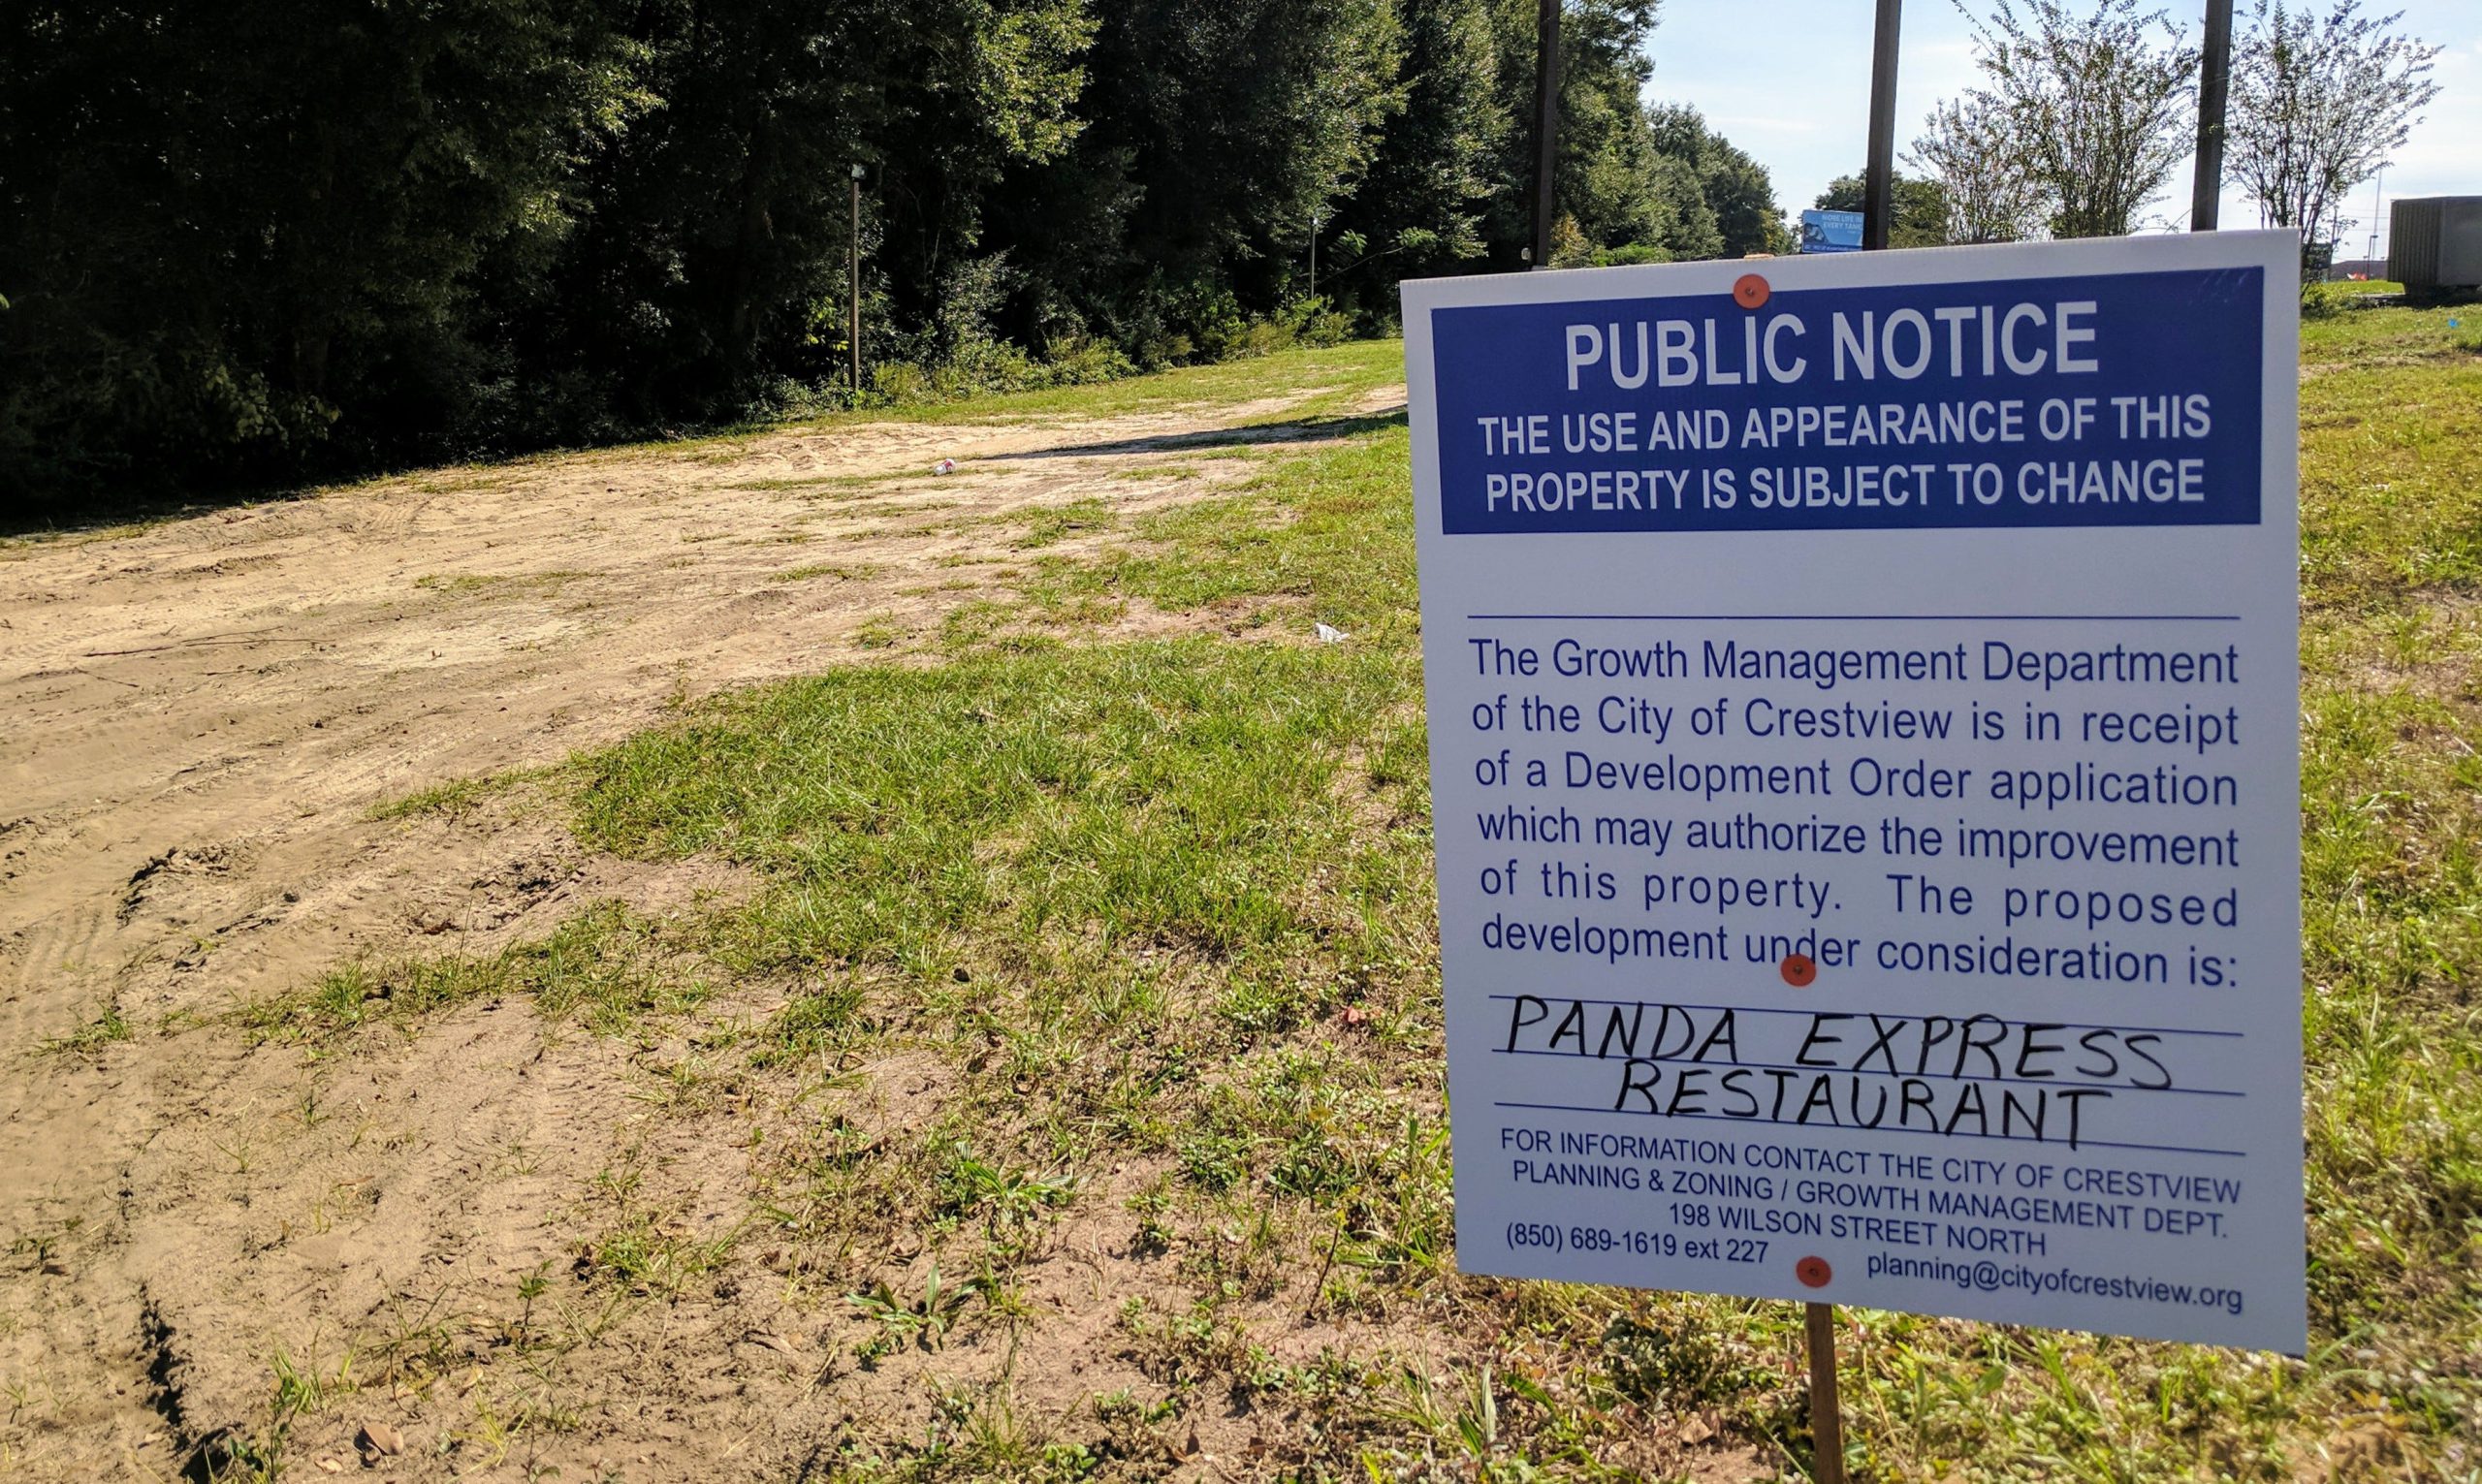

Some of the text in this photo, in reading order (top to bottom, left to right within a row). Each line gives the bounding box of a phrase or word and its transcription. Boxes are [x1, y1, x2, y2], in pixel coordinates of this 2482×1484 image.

[1566, 300, 2098, 391] PUBLIC NOTICE
[1478, 395, 2211, 456] THE USE AND APPEARANCE OF THIS
[1486, 459, 2204, 512] PROPERTY IS SUBJECT TO CHANGE
[1468, 638, 2240, 692] The Growth Management Department
[1472, 693, 2240, 755] of the City of Crestview is in receipt
[1476, 748, 2238, 811] of a Development Order application
[1477, 805, 2240, 869] which may authorize the improvement
[1480, 858, 2238, 931] of this property. The proposed
[1482, 912, 2237, 988] development under consideration is:
[1508, 995, 2172, 1089] PANDA EXPRESS
[1613, 1060, 2113, 1151] RESTAURANT
[1501, 1127, 2242, 1205] FOR INFORMATION CONTACT THE CITY OF CRESTVIEW
[1512, 1159, 2227, 1239] PLANNING & ZONING / GROWTH MANAGEMENT DEPT.
[1669, 1201, 2047, 1257] 198 WILSON STREET NORTH
[1506, 1221, 2243, 1316] (850) 689-1619 ext 227 planning@cityofcrestview.org
